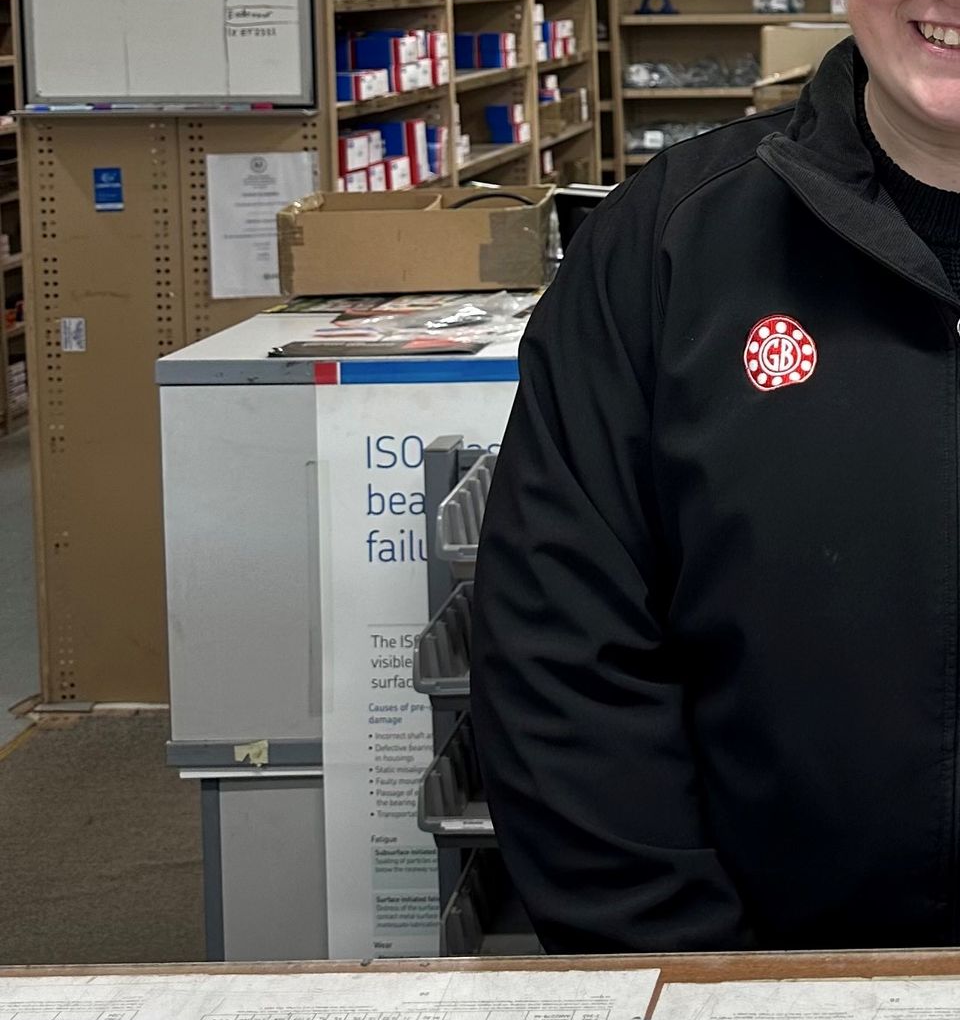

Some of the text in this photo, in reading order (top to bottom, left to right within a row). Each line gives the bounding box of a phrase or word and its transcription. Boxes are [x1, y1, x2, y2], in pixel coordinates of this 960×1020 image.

[763, 338, 794, 371] GB
[366, 435, 424, 469] ISO
[371, 635, 397, 648] The
[371, 655, 412, 668] visible
[368, 703, 398, 712] Causes
[400, 703, 409, 711] of
[368, 716, 402, 725] damage
[390, 799, 416, 807] bearing
[371, 834, 397, 844] Fatigue
